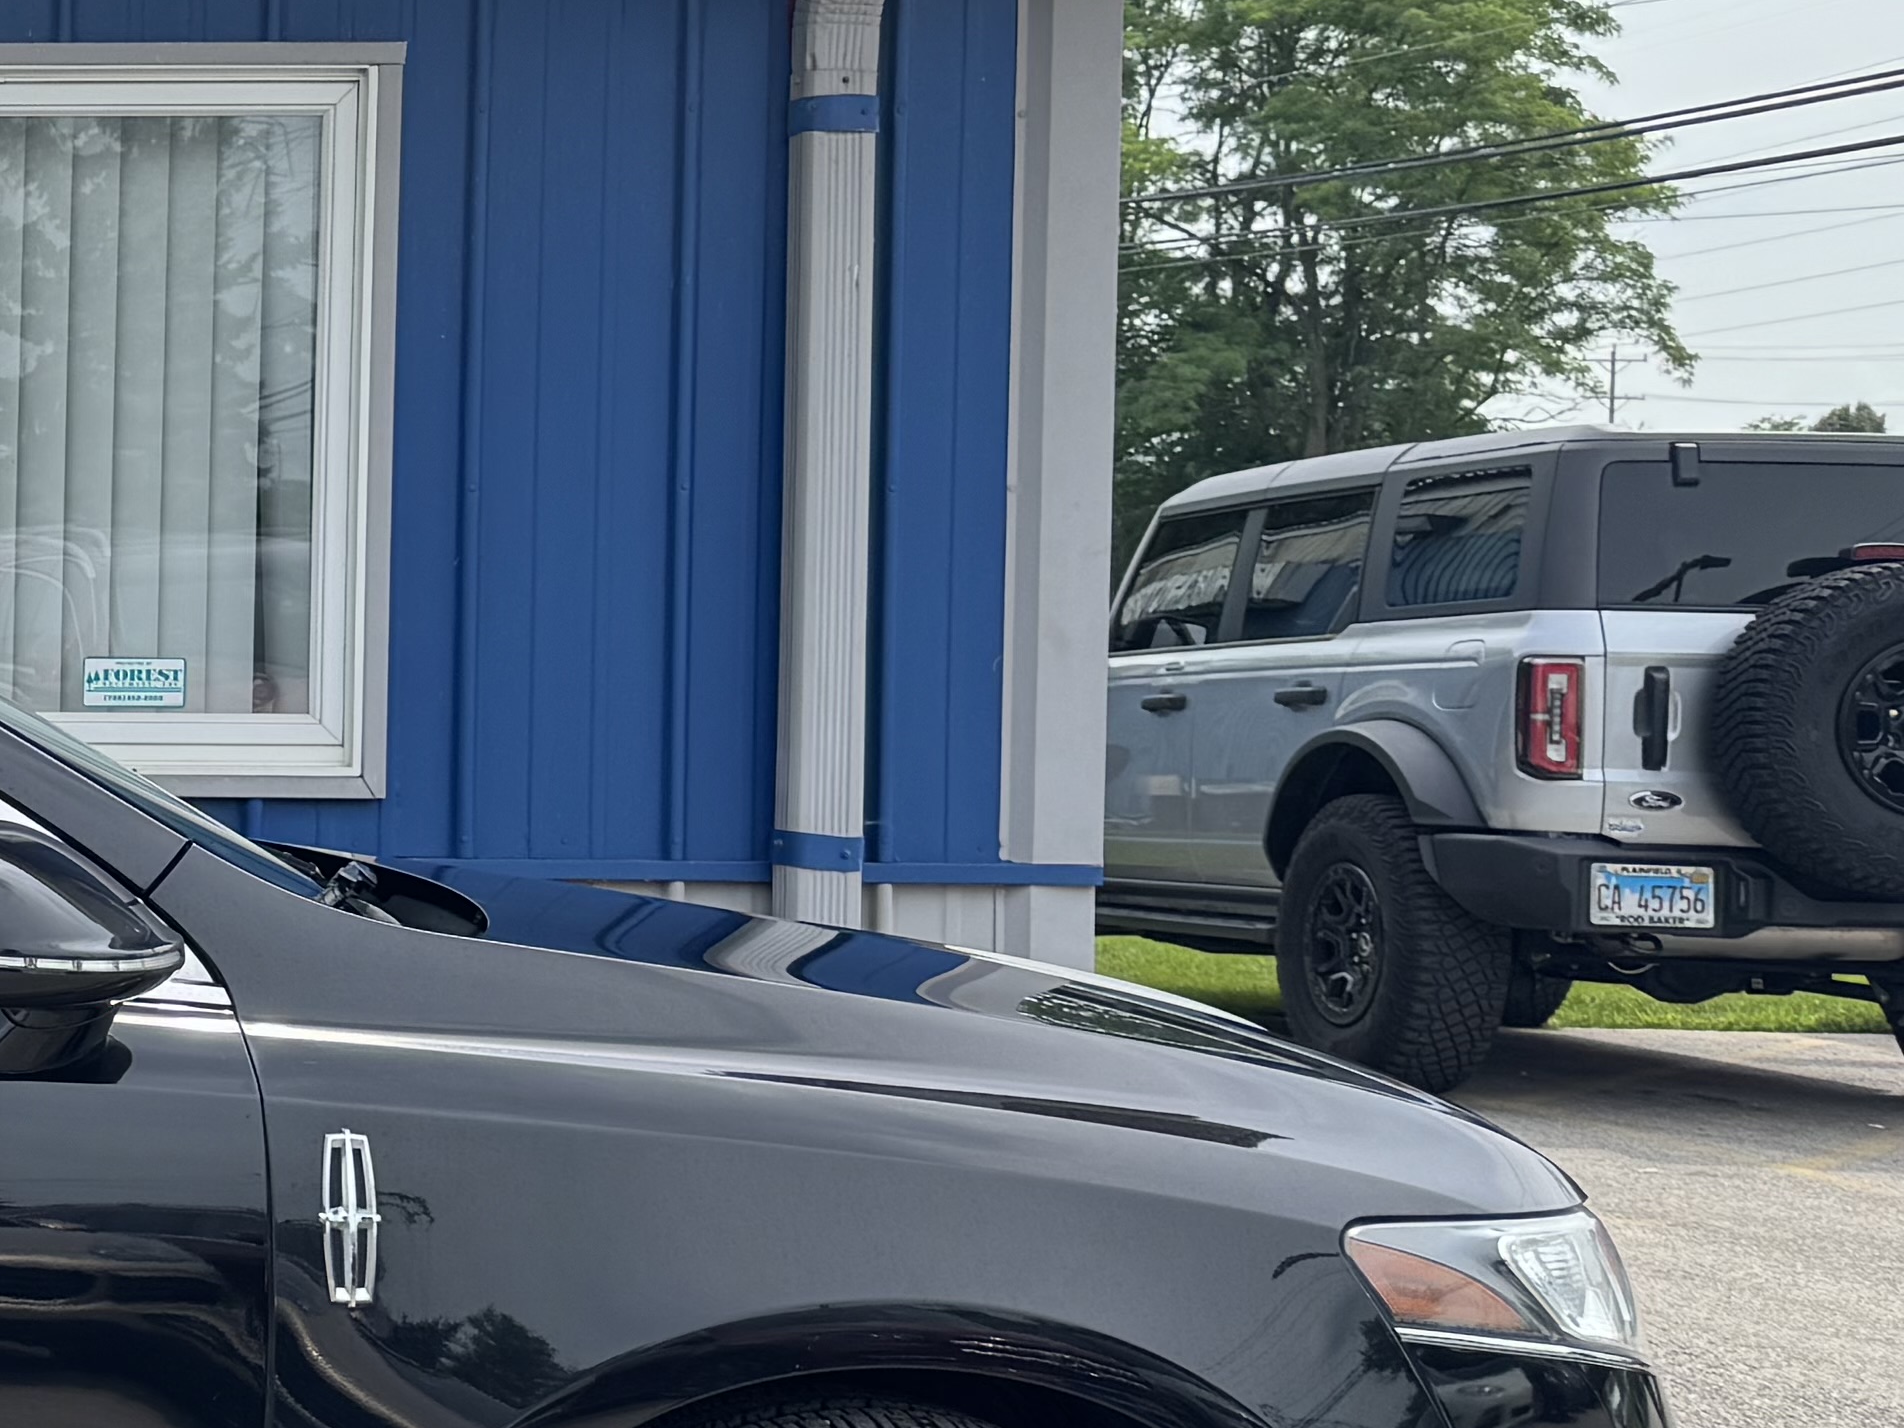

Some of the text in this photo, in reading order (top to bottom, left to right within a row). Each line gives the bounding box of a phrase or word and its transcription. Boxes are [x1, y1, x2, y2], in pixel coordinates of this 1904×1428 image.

[103, 668, 183, 682] FOREST
[1597, 883, 1706, 914] CA 45756
